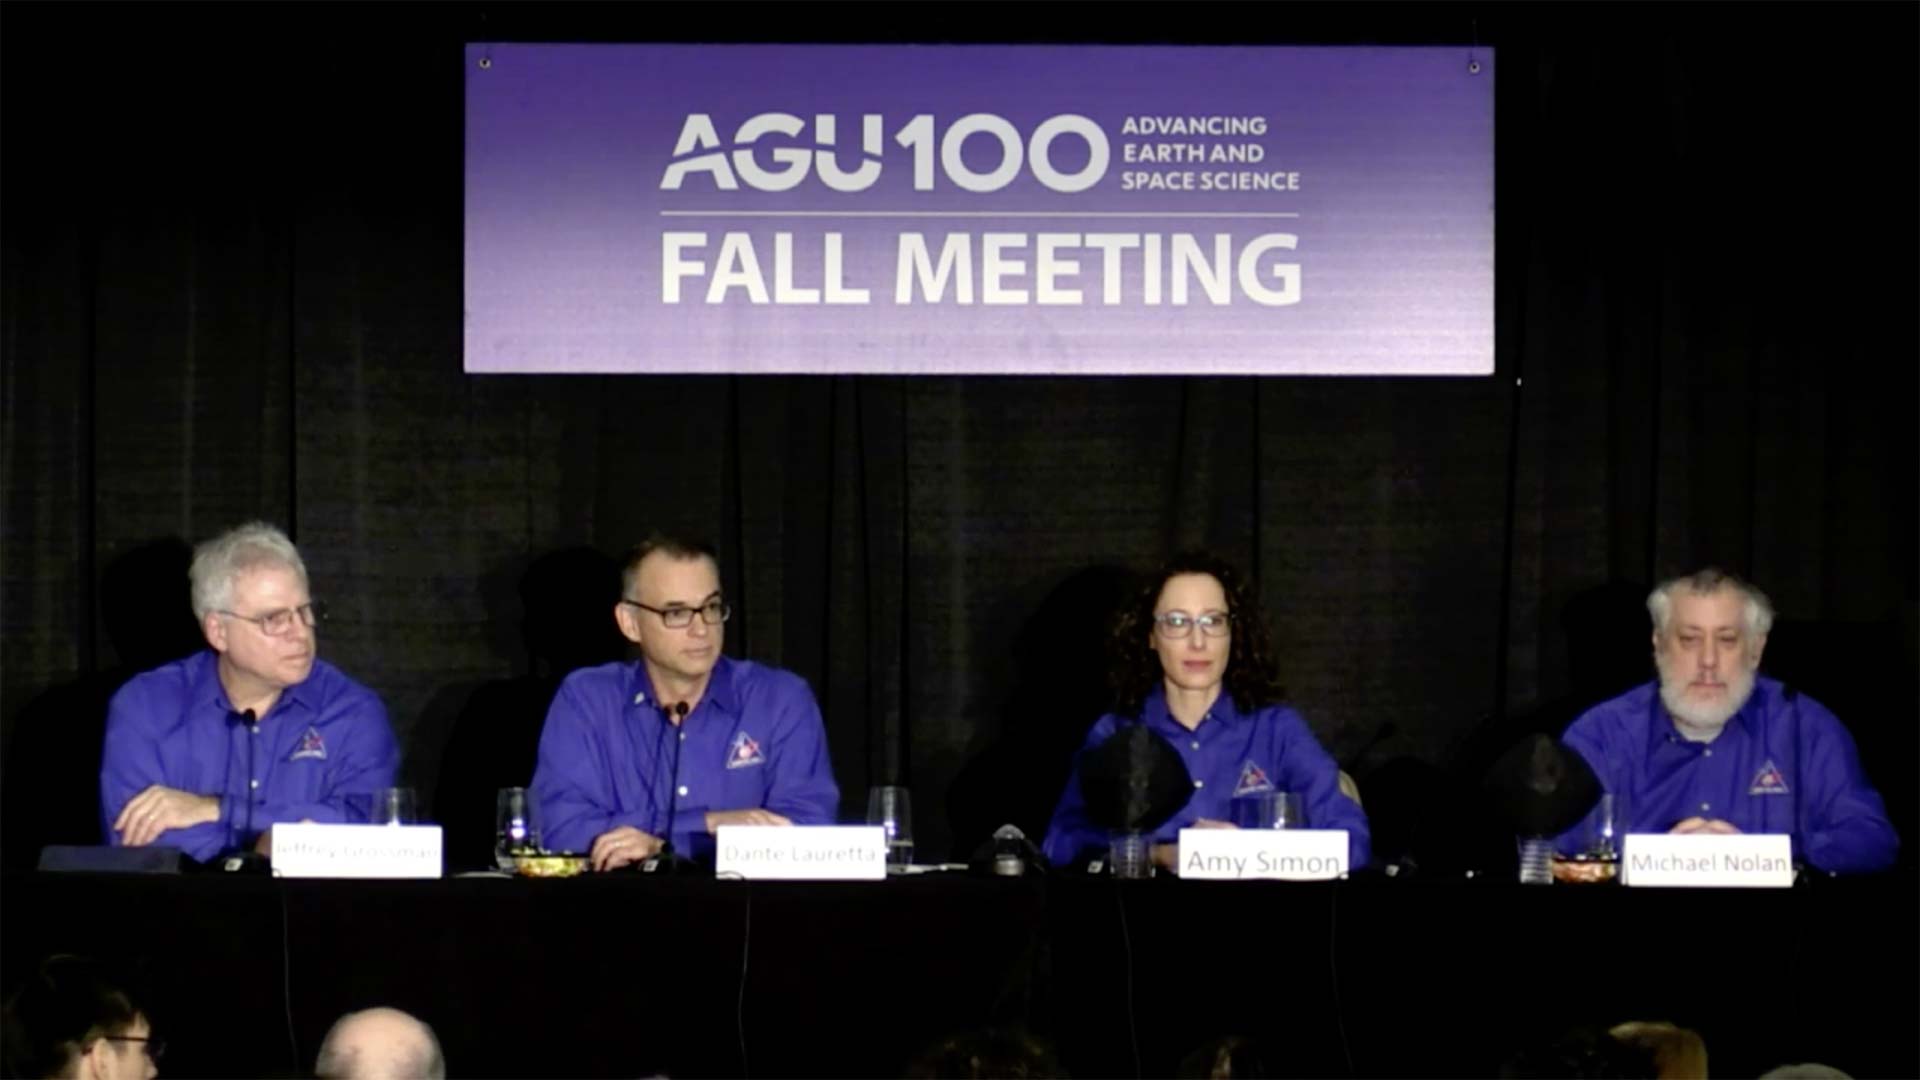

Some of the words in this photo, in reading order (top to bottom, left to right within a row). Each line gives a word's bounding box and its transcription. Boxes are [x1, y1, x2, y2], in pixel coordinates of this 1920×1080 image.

[1122, 117, 1267, 135] ADVANCING
[1124, 144, 1205, 162] EARTH
[1209, 144, 1264, 162] AND
[1122, 172, 1195, 190] SPACE
[1200, 172, 1300, 190] SCIENCE
[662, 232, 870, 304] FALL
[895, 232, 1301, 306] MEETING
[724, 844, 785, 862] Dante
[792, 844, 877, 862] Lauretta
[1631, 852, 1716, 872] Michael
[1724, 852, 1787, 872] Nolan
[1187, 850, 1247, 877] Amy
[1256, 850, 1340, 874] Simon
